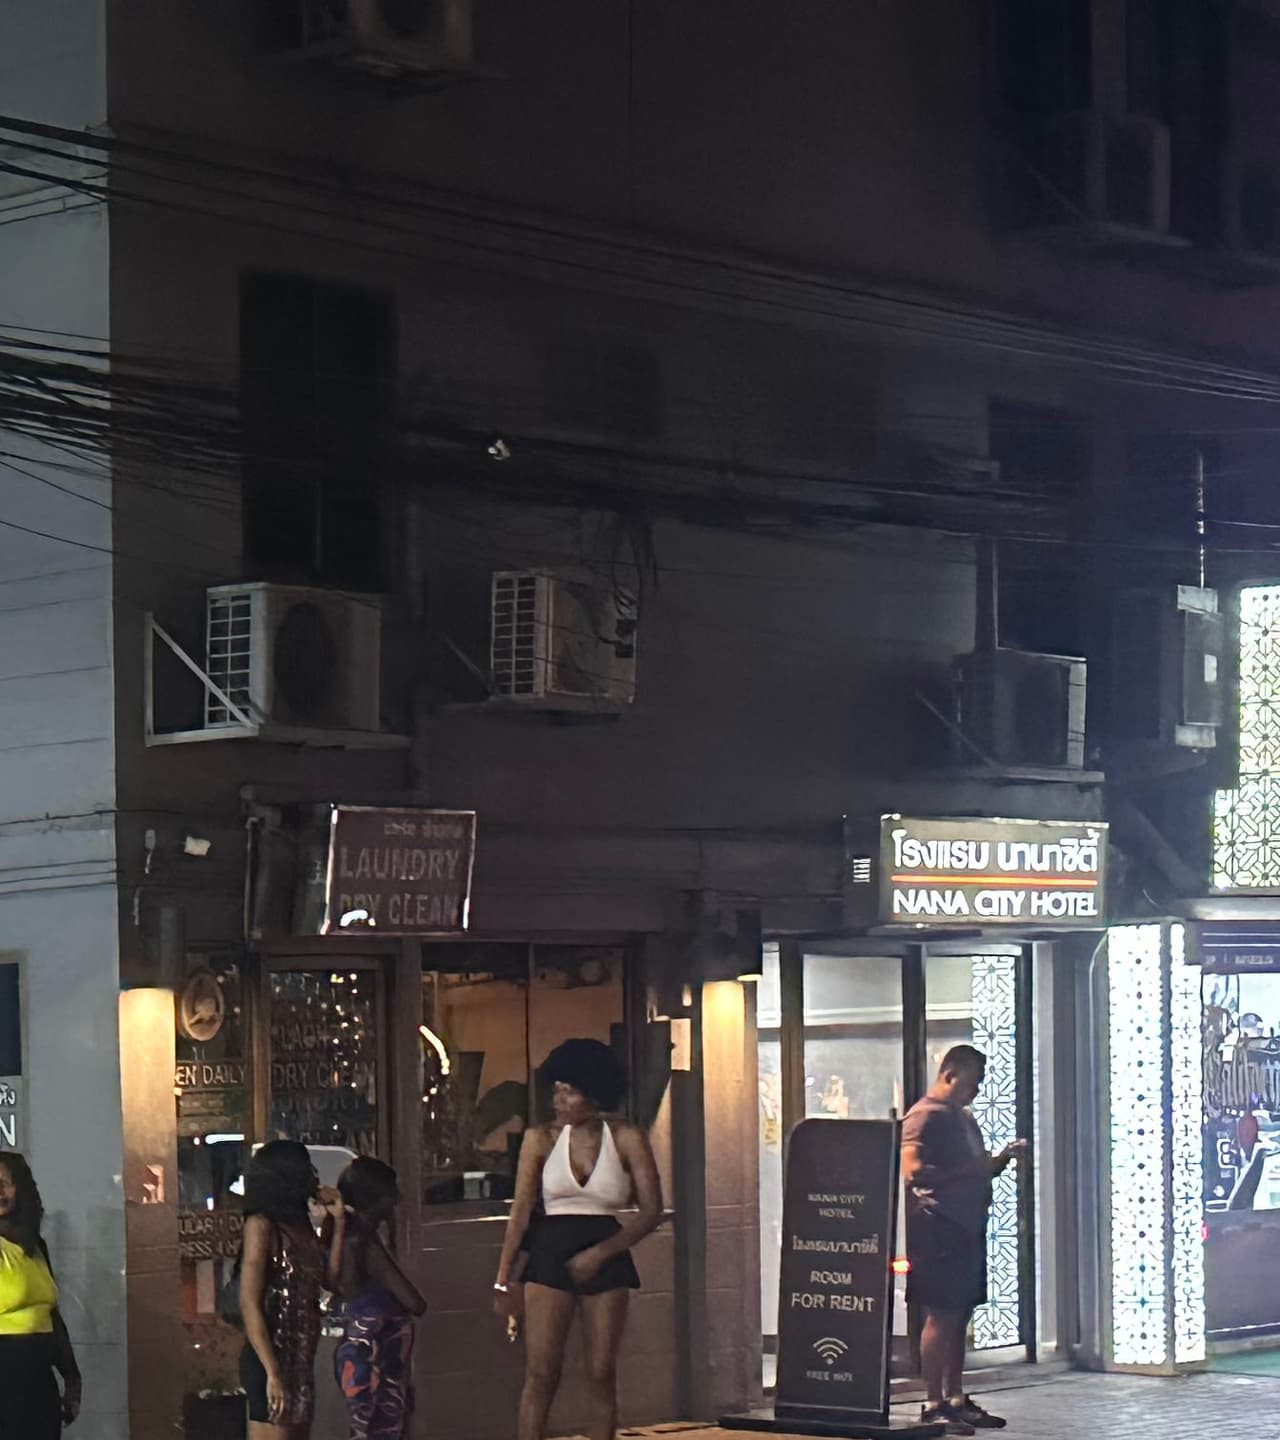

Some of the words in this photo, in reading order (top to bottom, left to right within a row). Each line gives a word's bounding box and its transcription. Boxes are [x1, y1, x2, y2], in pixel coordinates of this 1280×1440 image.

[339, 846, 460, 881] LAUNDRY
[891, 828, 990, 870] โรงแรม
[892, 888, 970, 916] NANA
[973, 889, 1027, 917] CITY
[1030, 890, 1099, 917] HOTEL
[810, 1270, 852, 1286] ROOM
[791, 1292, 825, 1309] FOR
[829, 1294, 876, 1313] RENT
